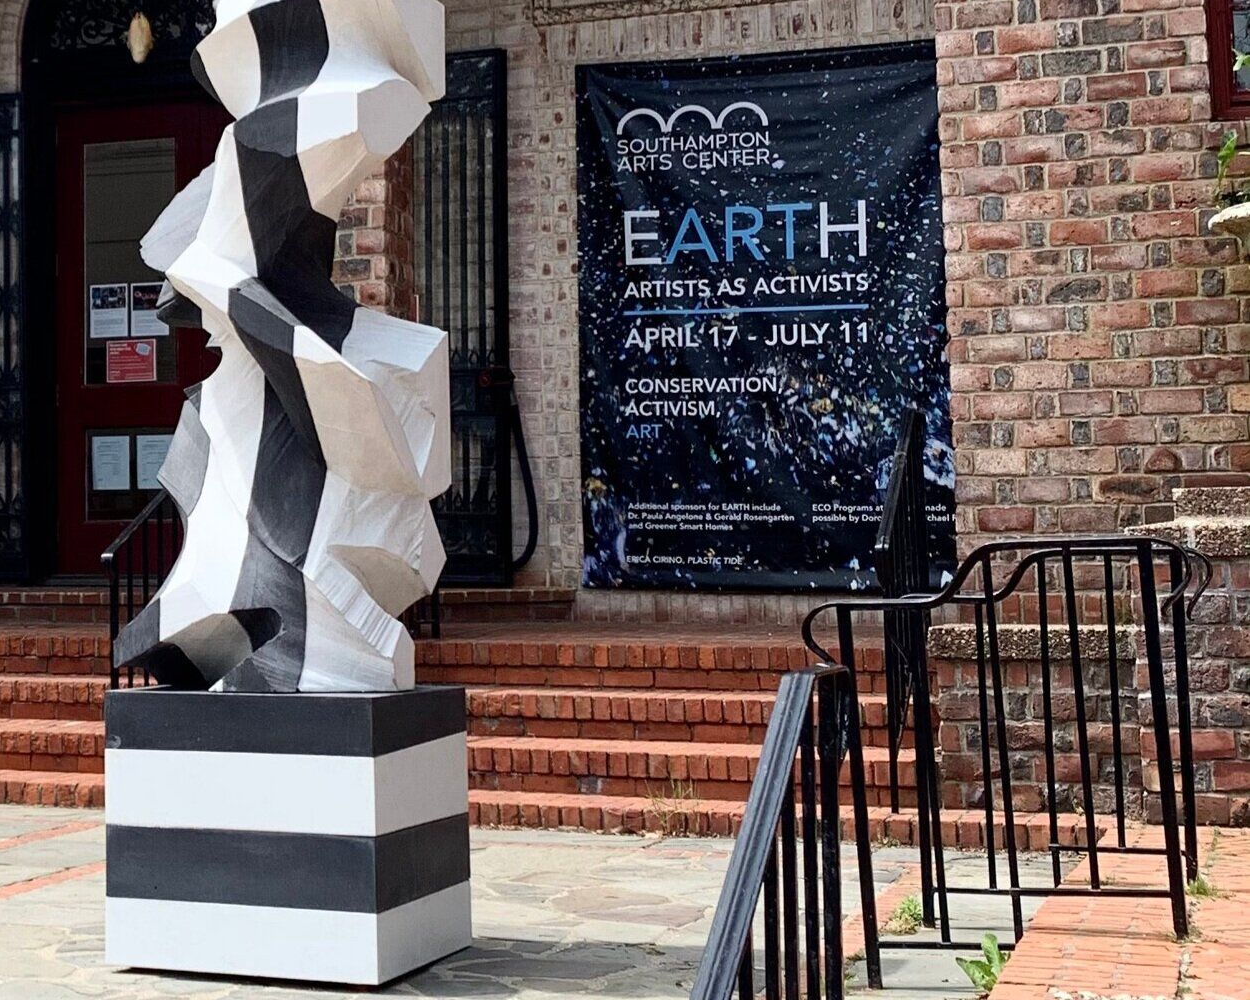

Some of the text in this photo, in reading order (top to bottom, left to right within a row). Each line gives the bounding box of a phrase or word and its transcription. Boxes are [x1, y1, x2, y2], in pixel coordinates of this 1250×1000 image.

[617, 131, 769, 155] SOUTHAMPTON
[617, 149, 770, 172] ARTS CENTER
[623, 200, 867, 265] EARTH
[624, 273, 869, 299] ARTISTS AS ACTIVISTS
[624, 326, 699, 348] APRIL
[709, 325, 738, 347] 17
[765, 324, 829, 346] JULY
[840, 322, 869, 343] 11
[625, 376, 783, 395] CONSERVATION,
[625, 401, 721, 418] ACTIVISM,
[626, 424, 662, 439] ART
[628, 502, 781, 513] Additional sponsors for EARTH include
[812, 504, 884, 513] ECO Programs at
[628, 512, 795, 523] Dr. Paula Angelone & Gerald Rosengarten
[812, 514, 847, 523] possible
[848, 514, 859, 524] by
[628, 522, 734, 531] and Greener Smart Homes
[626, 556, 651, 564] ERICA
[687, 556, 722, 565] PLASTIC
[723, 556, 744, 565] TIDE
